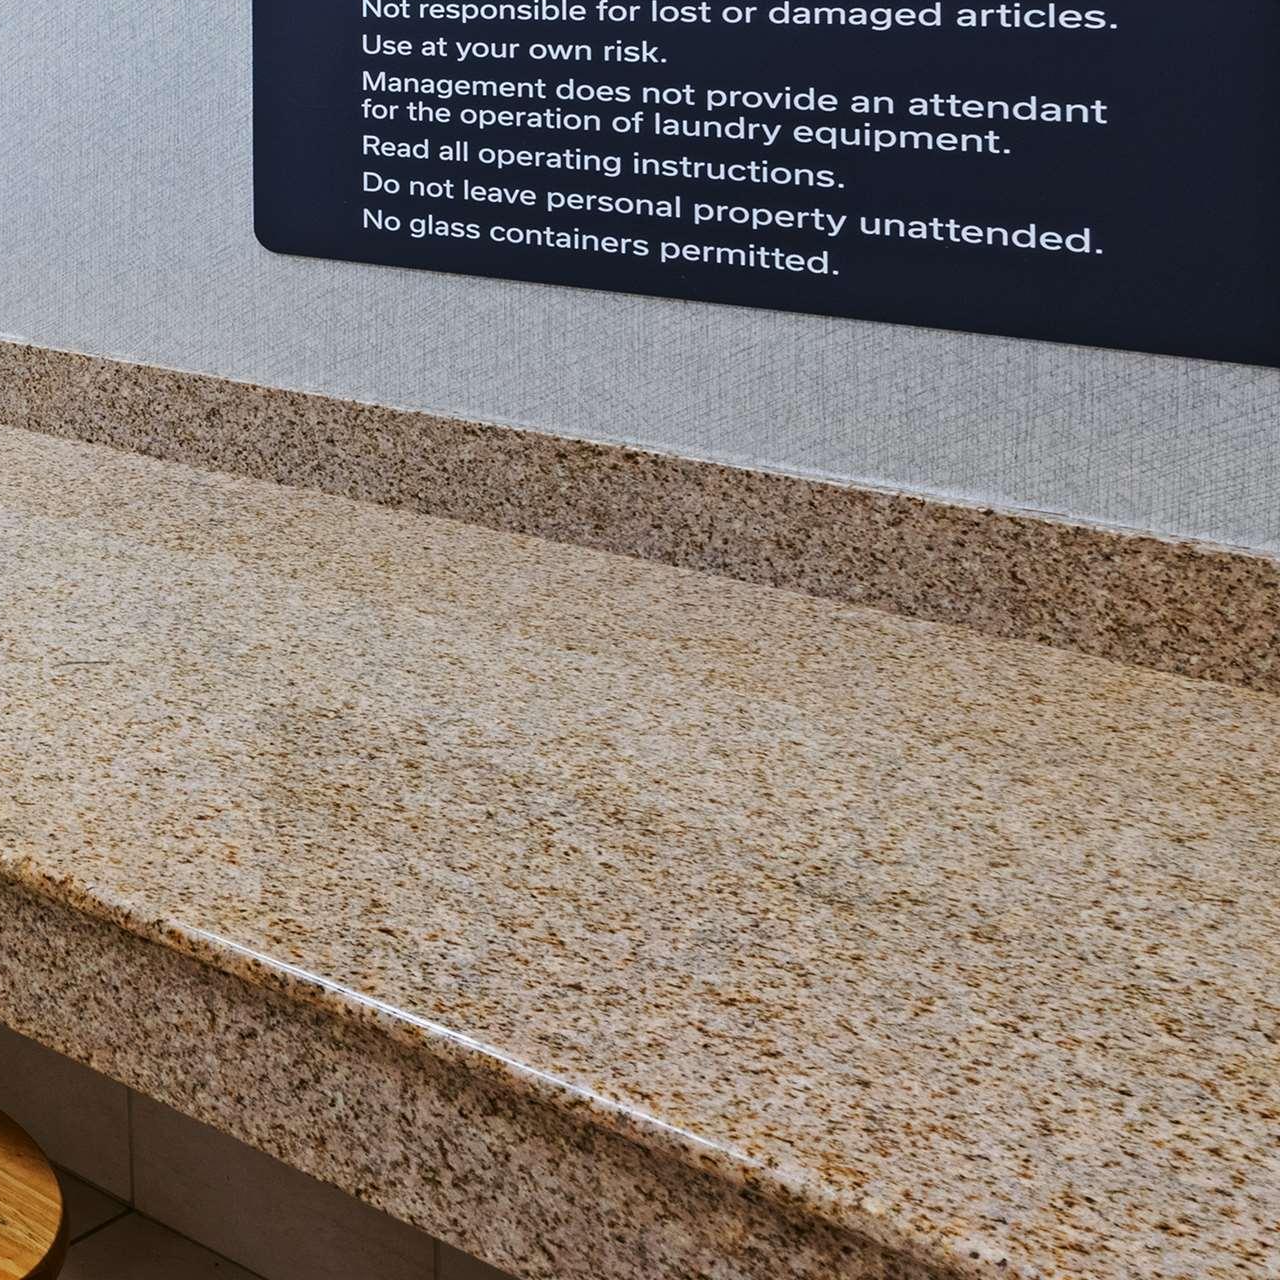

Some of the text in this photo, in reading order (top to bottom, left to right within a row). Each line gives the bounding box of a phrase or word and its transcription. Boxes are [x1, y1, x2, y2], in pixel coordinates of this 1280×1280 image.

[651, 0, 712, 24] lost
[721, 6, 758, 24] or
[768, 0, 942, 31] damaged
[956, 2, 1118, 30] articles.
[362, 33, 667, 64] Use at your own risk.
[362, 70, 1108, 125] Management does not provide an attendant
[360, 97, 1011, 154] for the operation of laundry equipment.
[362, 134, 845, 189] Read all operating instructions.
[363, 171, 1103, 255] Do not leave personal property unattended.
[363, 207, 839, 276] No glass containers permitted.
